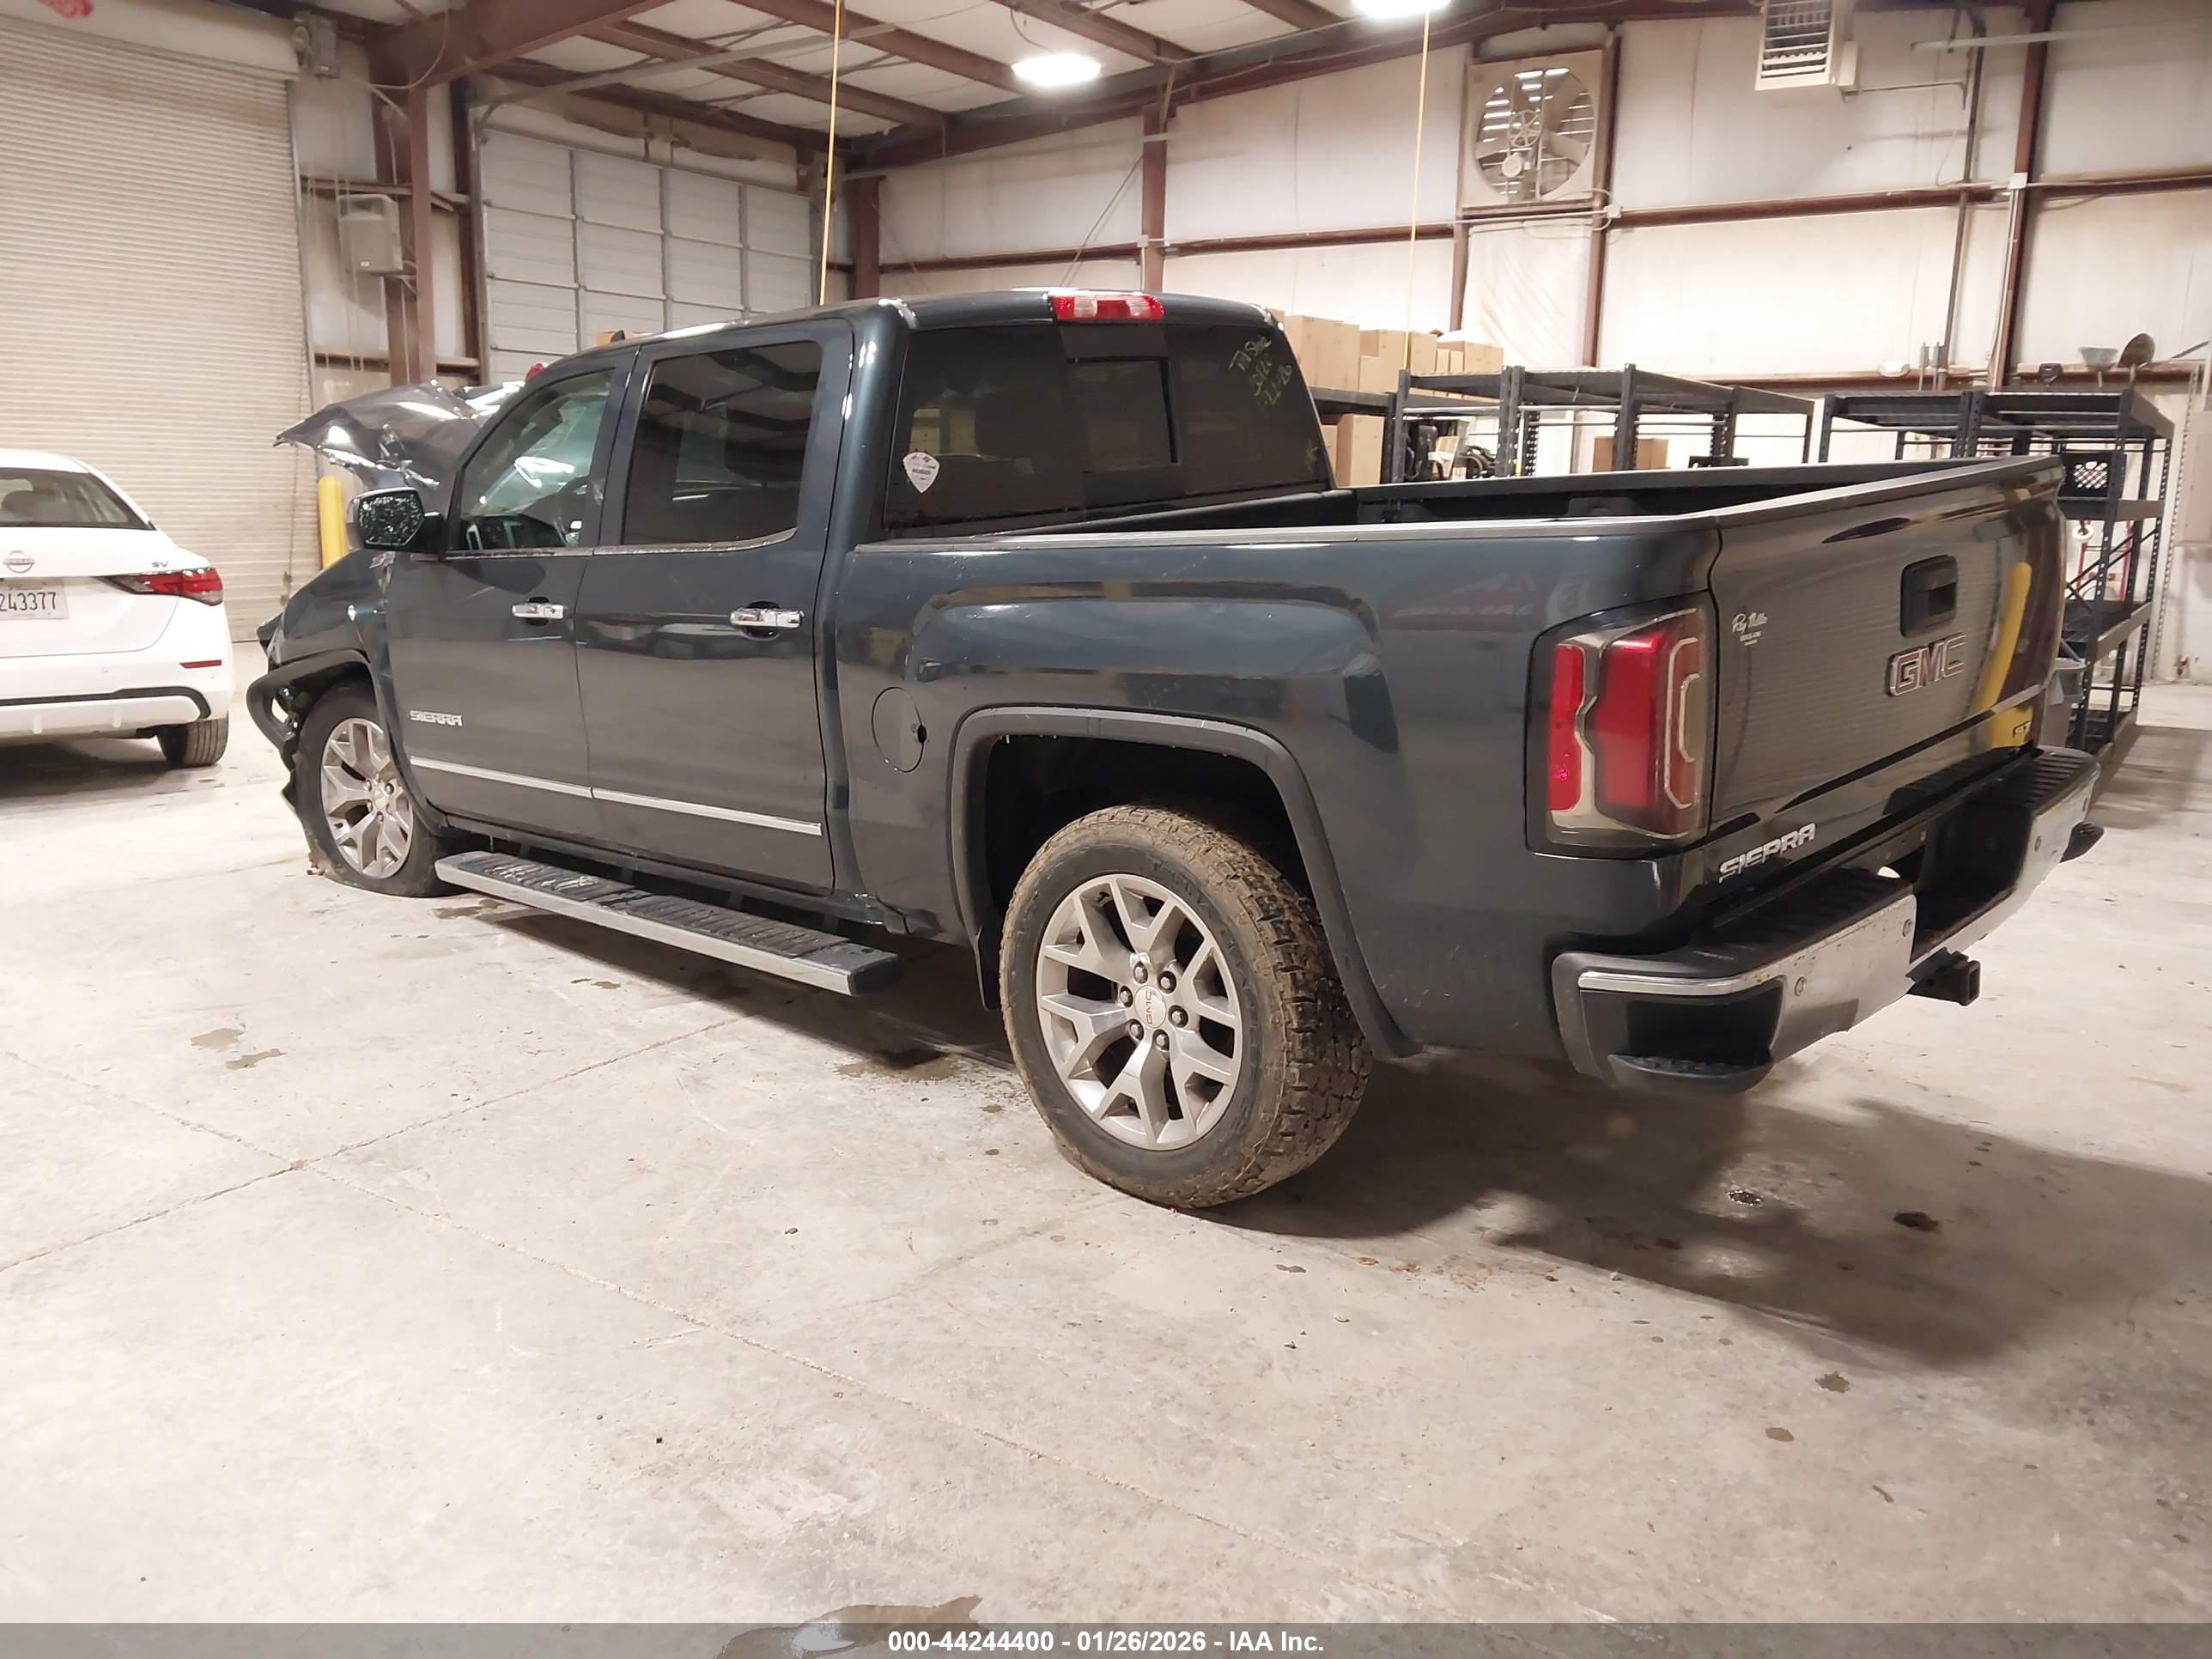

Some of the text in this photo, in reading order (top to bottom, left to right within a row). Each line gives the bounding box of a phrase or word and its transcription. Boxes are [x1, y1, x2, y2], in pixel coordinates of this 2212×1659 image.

[0, 592, 57, 611] 243377
[1889, 634, 1967, 696] GMC
[409, 709, 463, 726] SIERRA
[1718, 823, 1816, 884] SIERRA
[1145, 989, 1153, 1025] GMC
